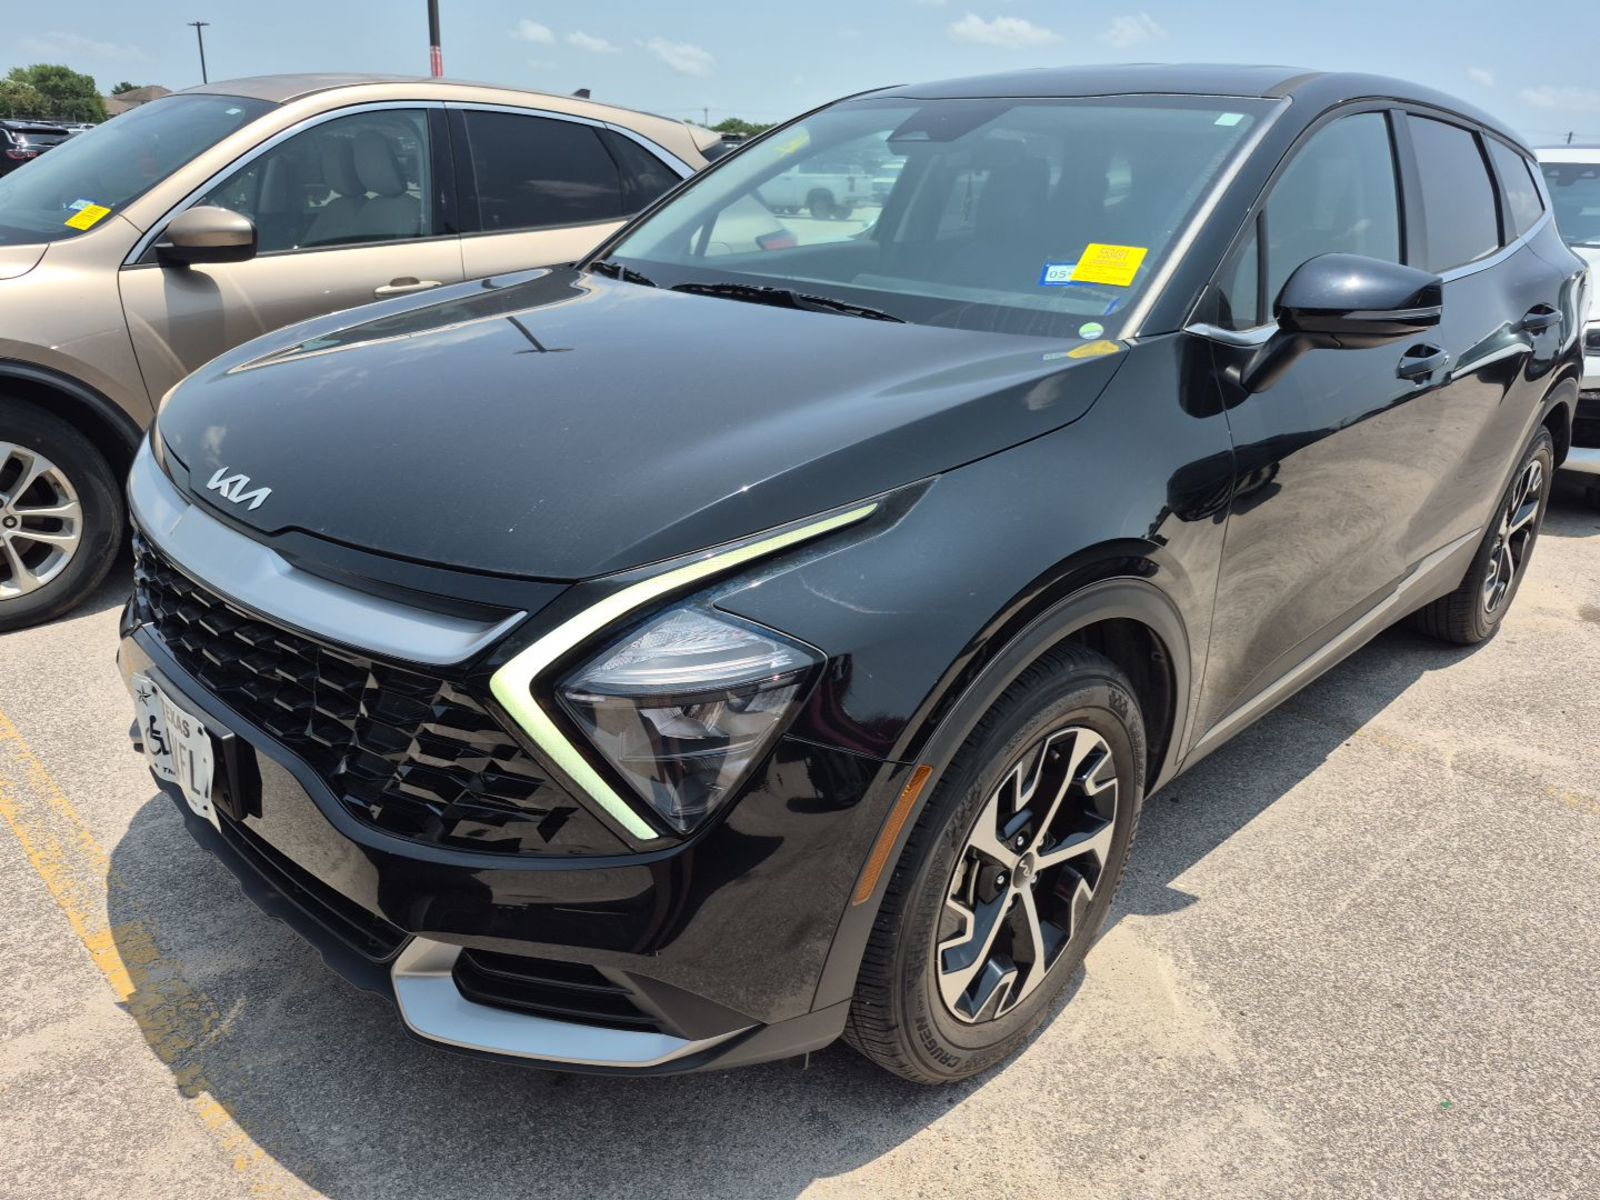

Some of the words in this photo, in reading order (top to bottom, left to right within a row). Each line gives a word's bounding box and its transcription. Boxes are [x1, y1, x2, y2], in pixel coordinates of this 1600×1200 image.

[1049, 270, 1066, 279] 05
[206, 466, 273, 511] KIA
[914, 1016, 961, 1069] CRUGEN
